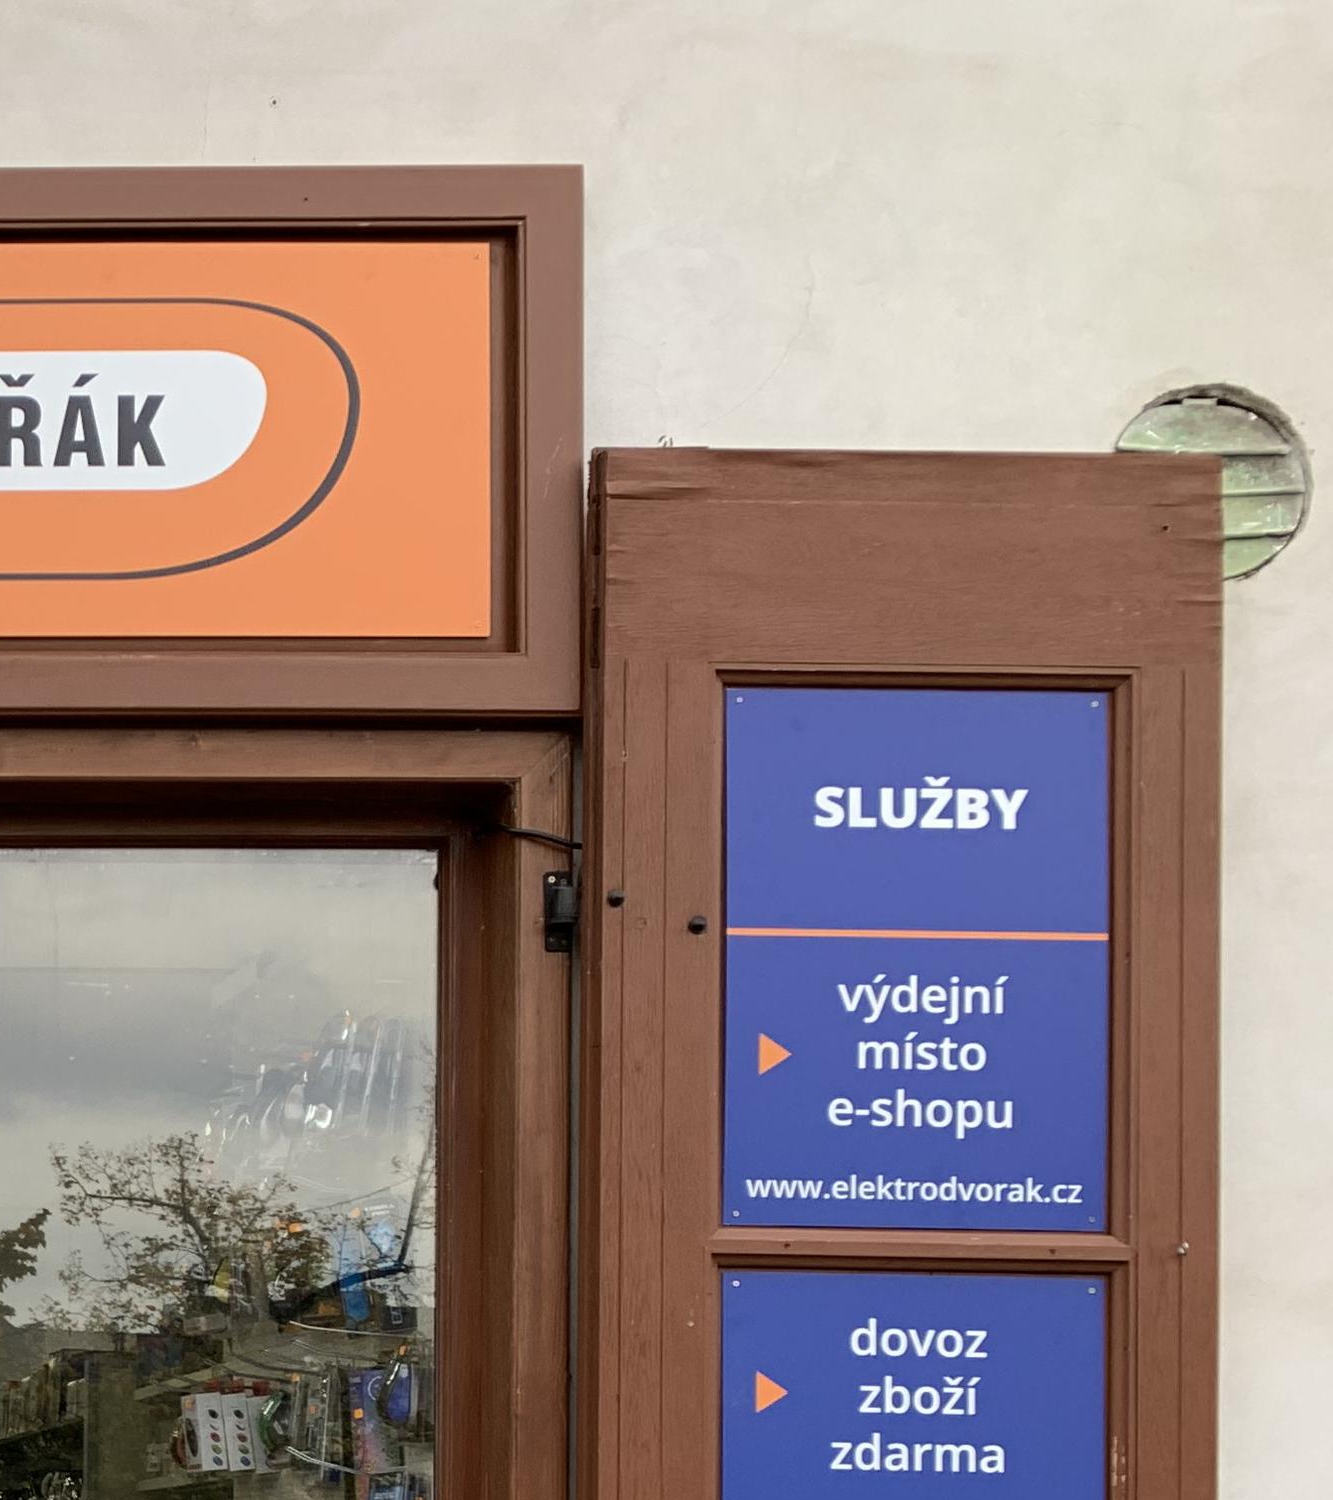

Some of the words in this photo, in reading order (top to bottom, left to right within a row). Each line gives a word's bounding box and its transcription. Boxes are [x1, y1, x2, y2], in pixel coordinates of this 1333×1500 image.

[814, 776, 1029, 829] SLUŽBY
[838, 974, 1009, 1025] výdejní
[857, 1031, 986, 1071] místo
[827, 1089, 1013, 1139] e-shopu
[746, 1175, 1083, 1204] www.elektrodvorak.cz
[850, 1318, 988, 1358] dovoz
[859, 1375, 980, 1415] zboží
[830, 1433, 1006, 1473] zdarma
